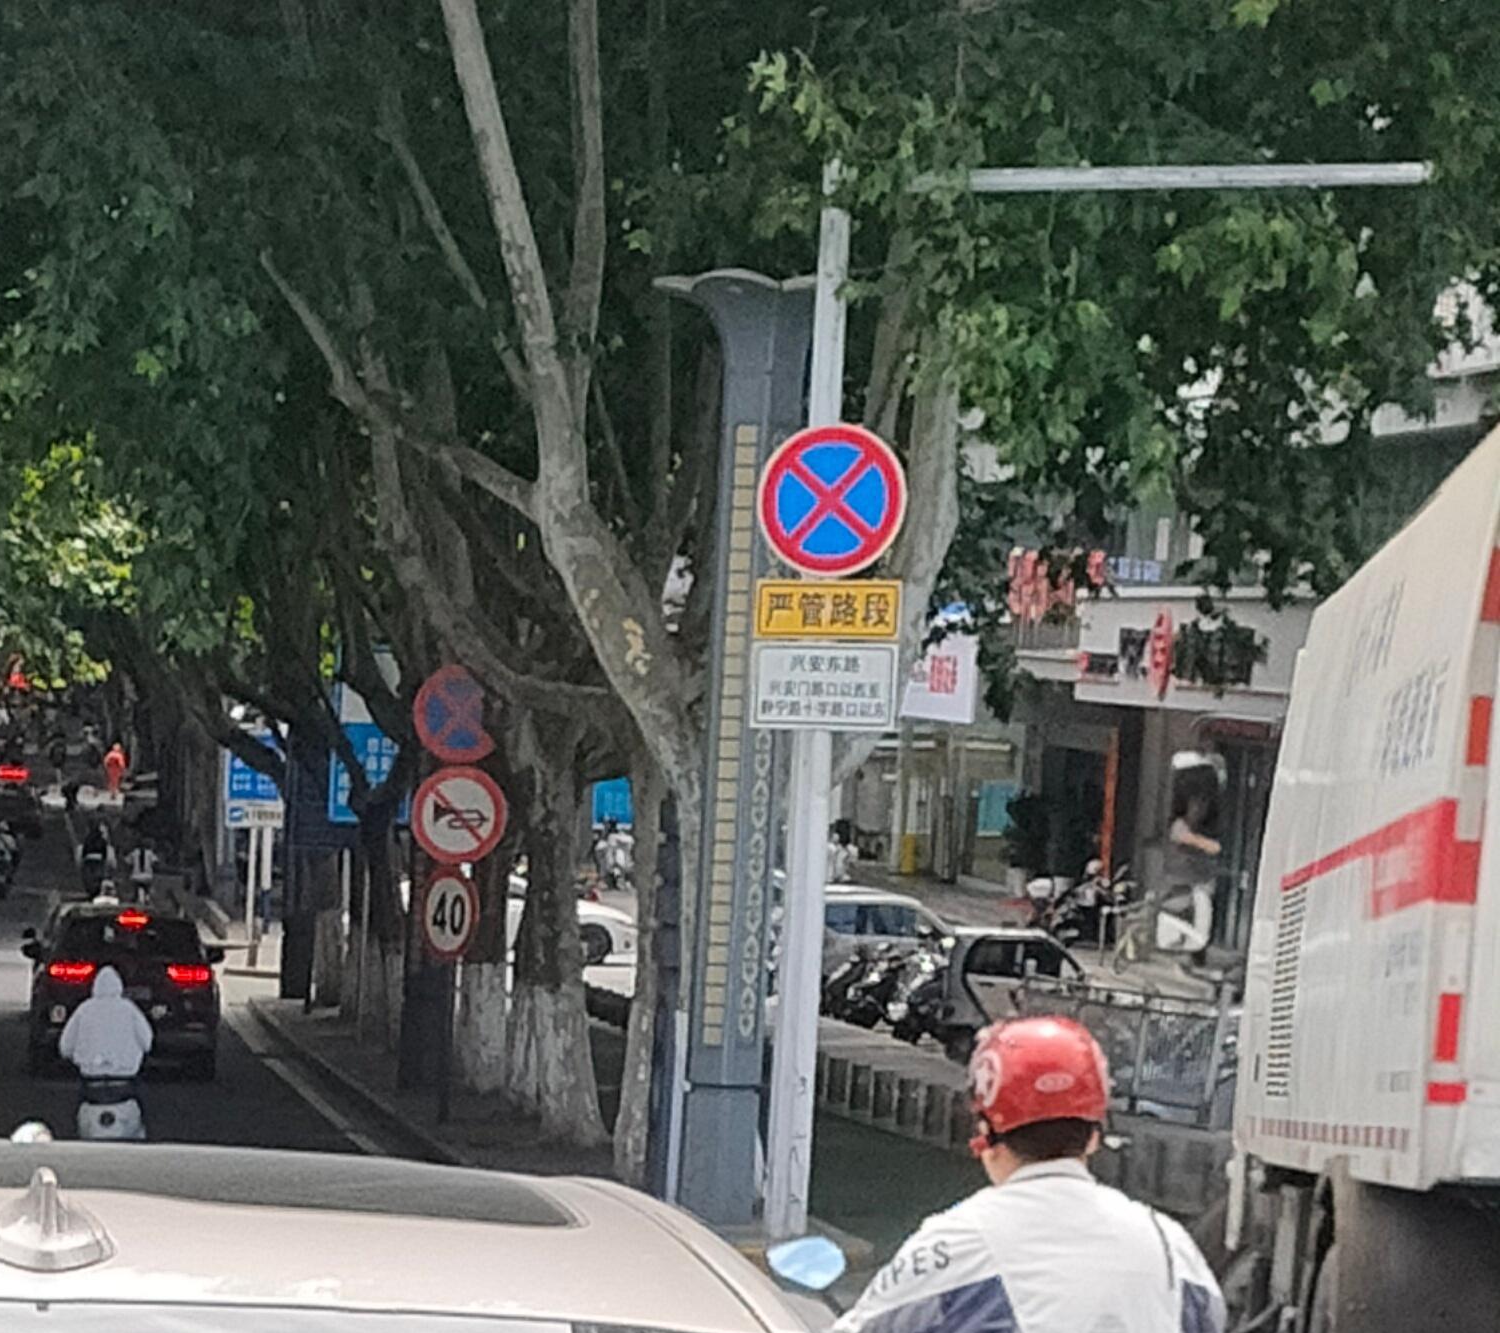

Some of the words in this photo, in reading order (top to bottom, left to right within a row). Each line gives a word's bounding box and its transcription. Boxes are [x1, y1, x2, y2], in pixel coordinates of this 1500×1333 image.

[765, 592, 889, 628] 严管路段
[432, 890, 466, 936] 40
